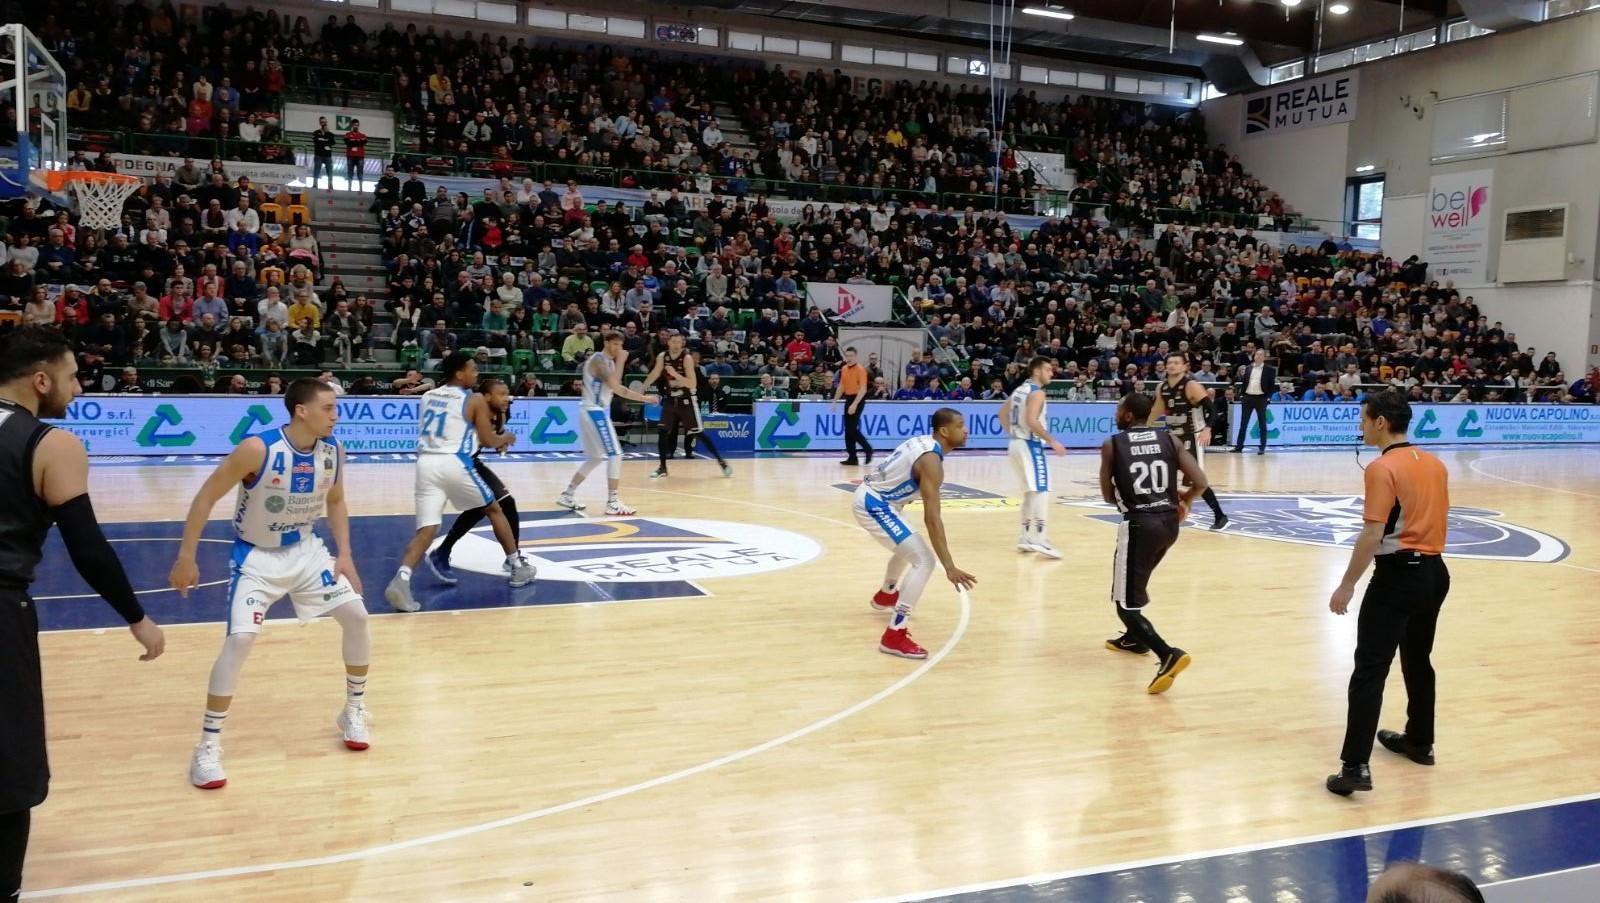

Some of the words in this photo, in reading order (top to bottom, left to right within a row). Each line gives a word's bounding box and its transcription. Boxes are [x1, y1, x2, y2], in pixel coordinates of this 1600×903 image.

[1276, 78, 1350, 112] REALE
[1275, 102, 1348, 128] MUTUA
[1431, 187, 1465, 212] be
[1431, 186, 1472, 228] well
[422, 409, 448, 437] 21
[1283, 407, 1329, 421] NUOVA
[1333, 407, 1361, 421] CAP
[1486, 407, 1527, 421] NUOVA
[1530, 407, 1590, 421] CAPOLINO
[1130, 444, 1161, 455] OLIVER
[271, 452, 285, 475] 4
[1129, 460, 1169, 495] 20
[570, 547, 776, 574] REALE
[596, 552, 800, 580] MUTUA
